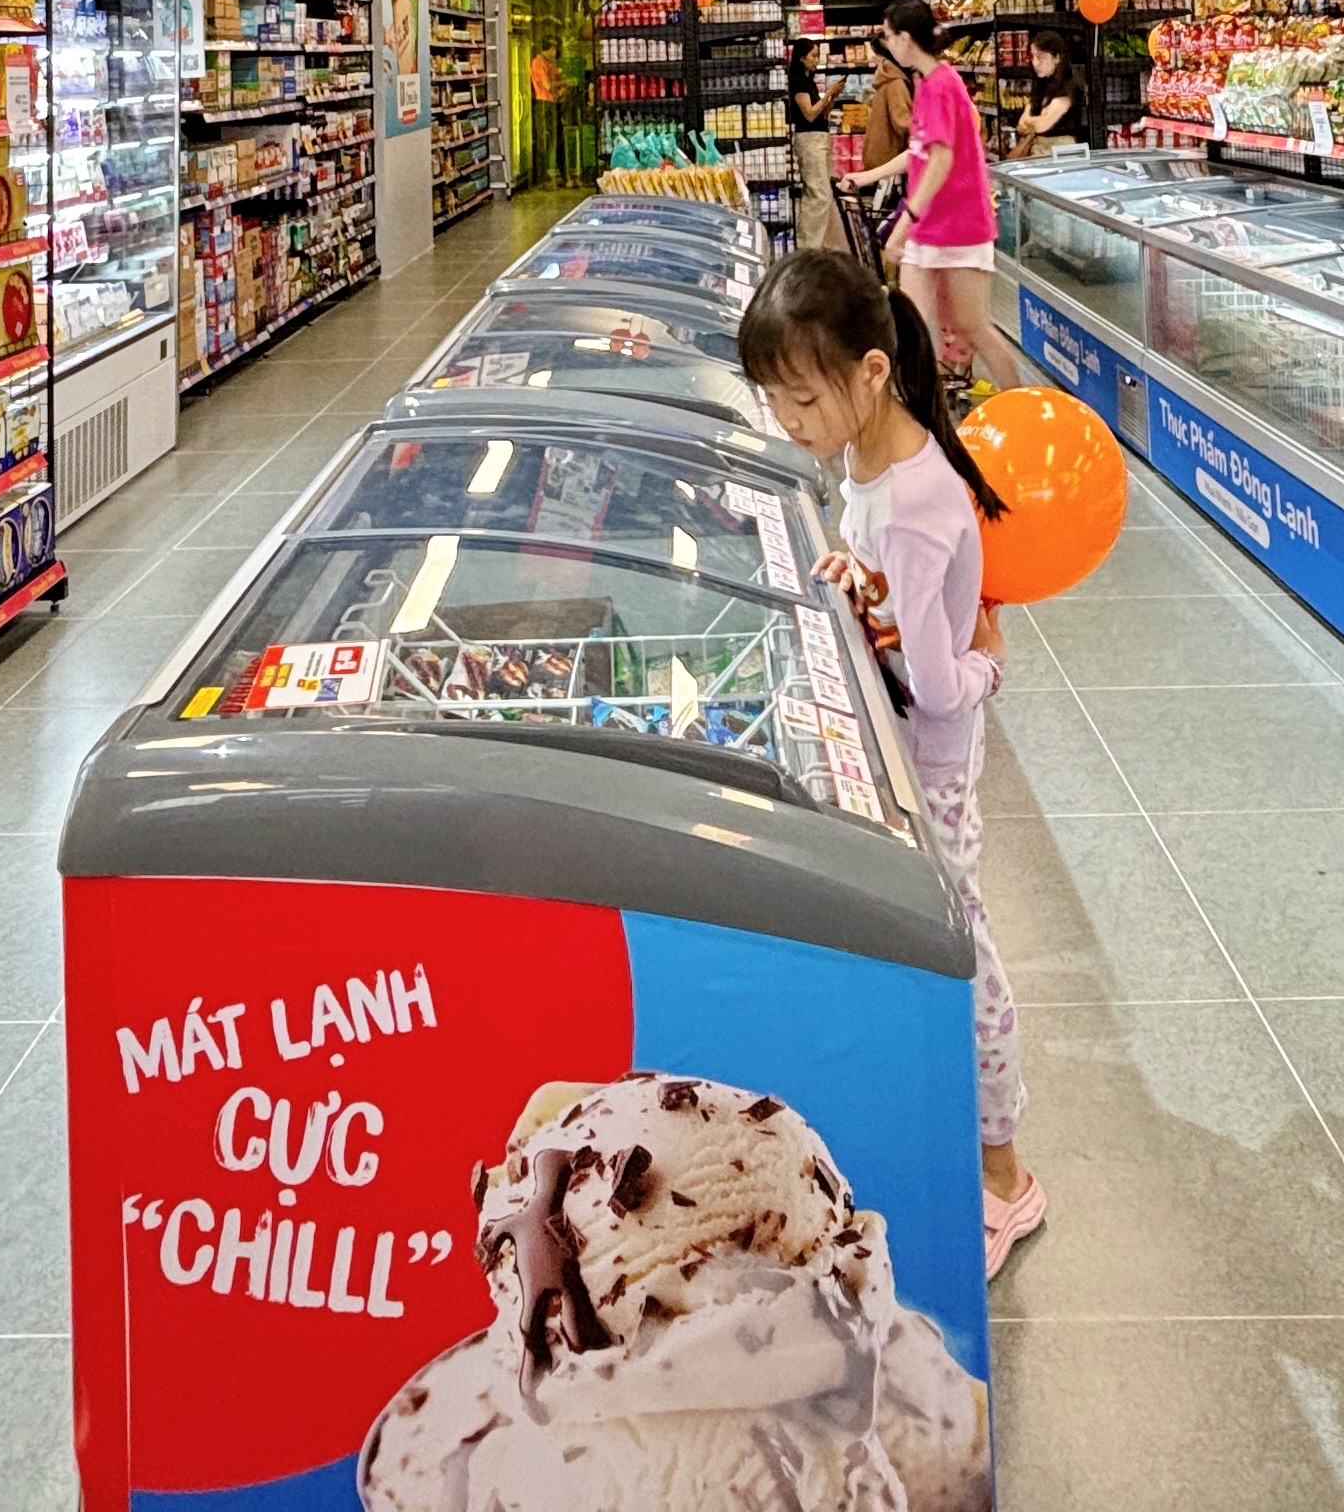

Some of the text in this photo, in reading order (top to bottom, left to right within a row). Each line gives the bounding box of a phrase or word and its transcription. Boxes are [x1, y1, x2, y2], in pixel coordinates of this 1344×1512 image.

[1159, 397, 1320, 550] Thực Phẩm Đông Lạnh
[116, 962, 438, 1094] MÁT LẠNH
[213, 1086, 385, 1207] CỰC
